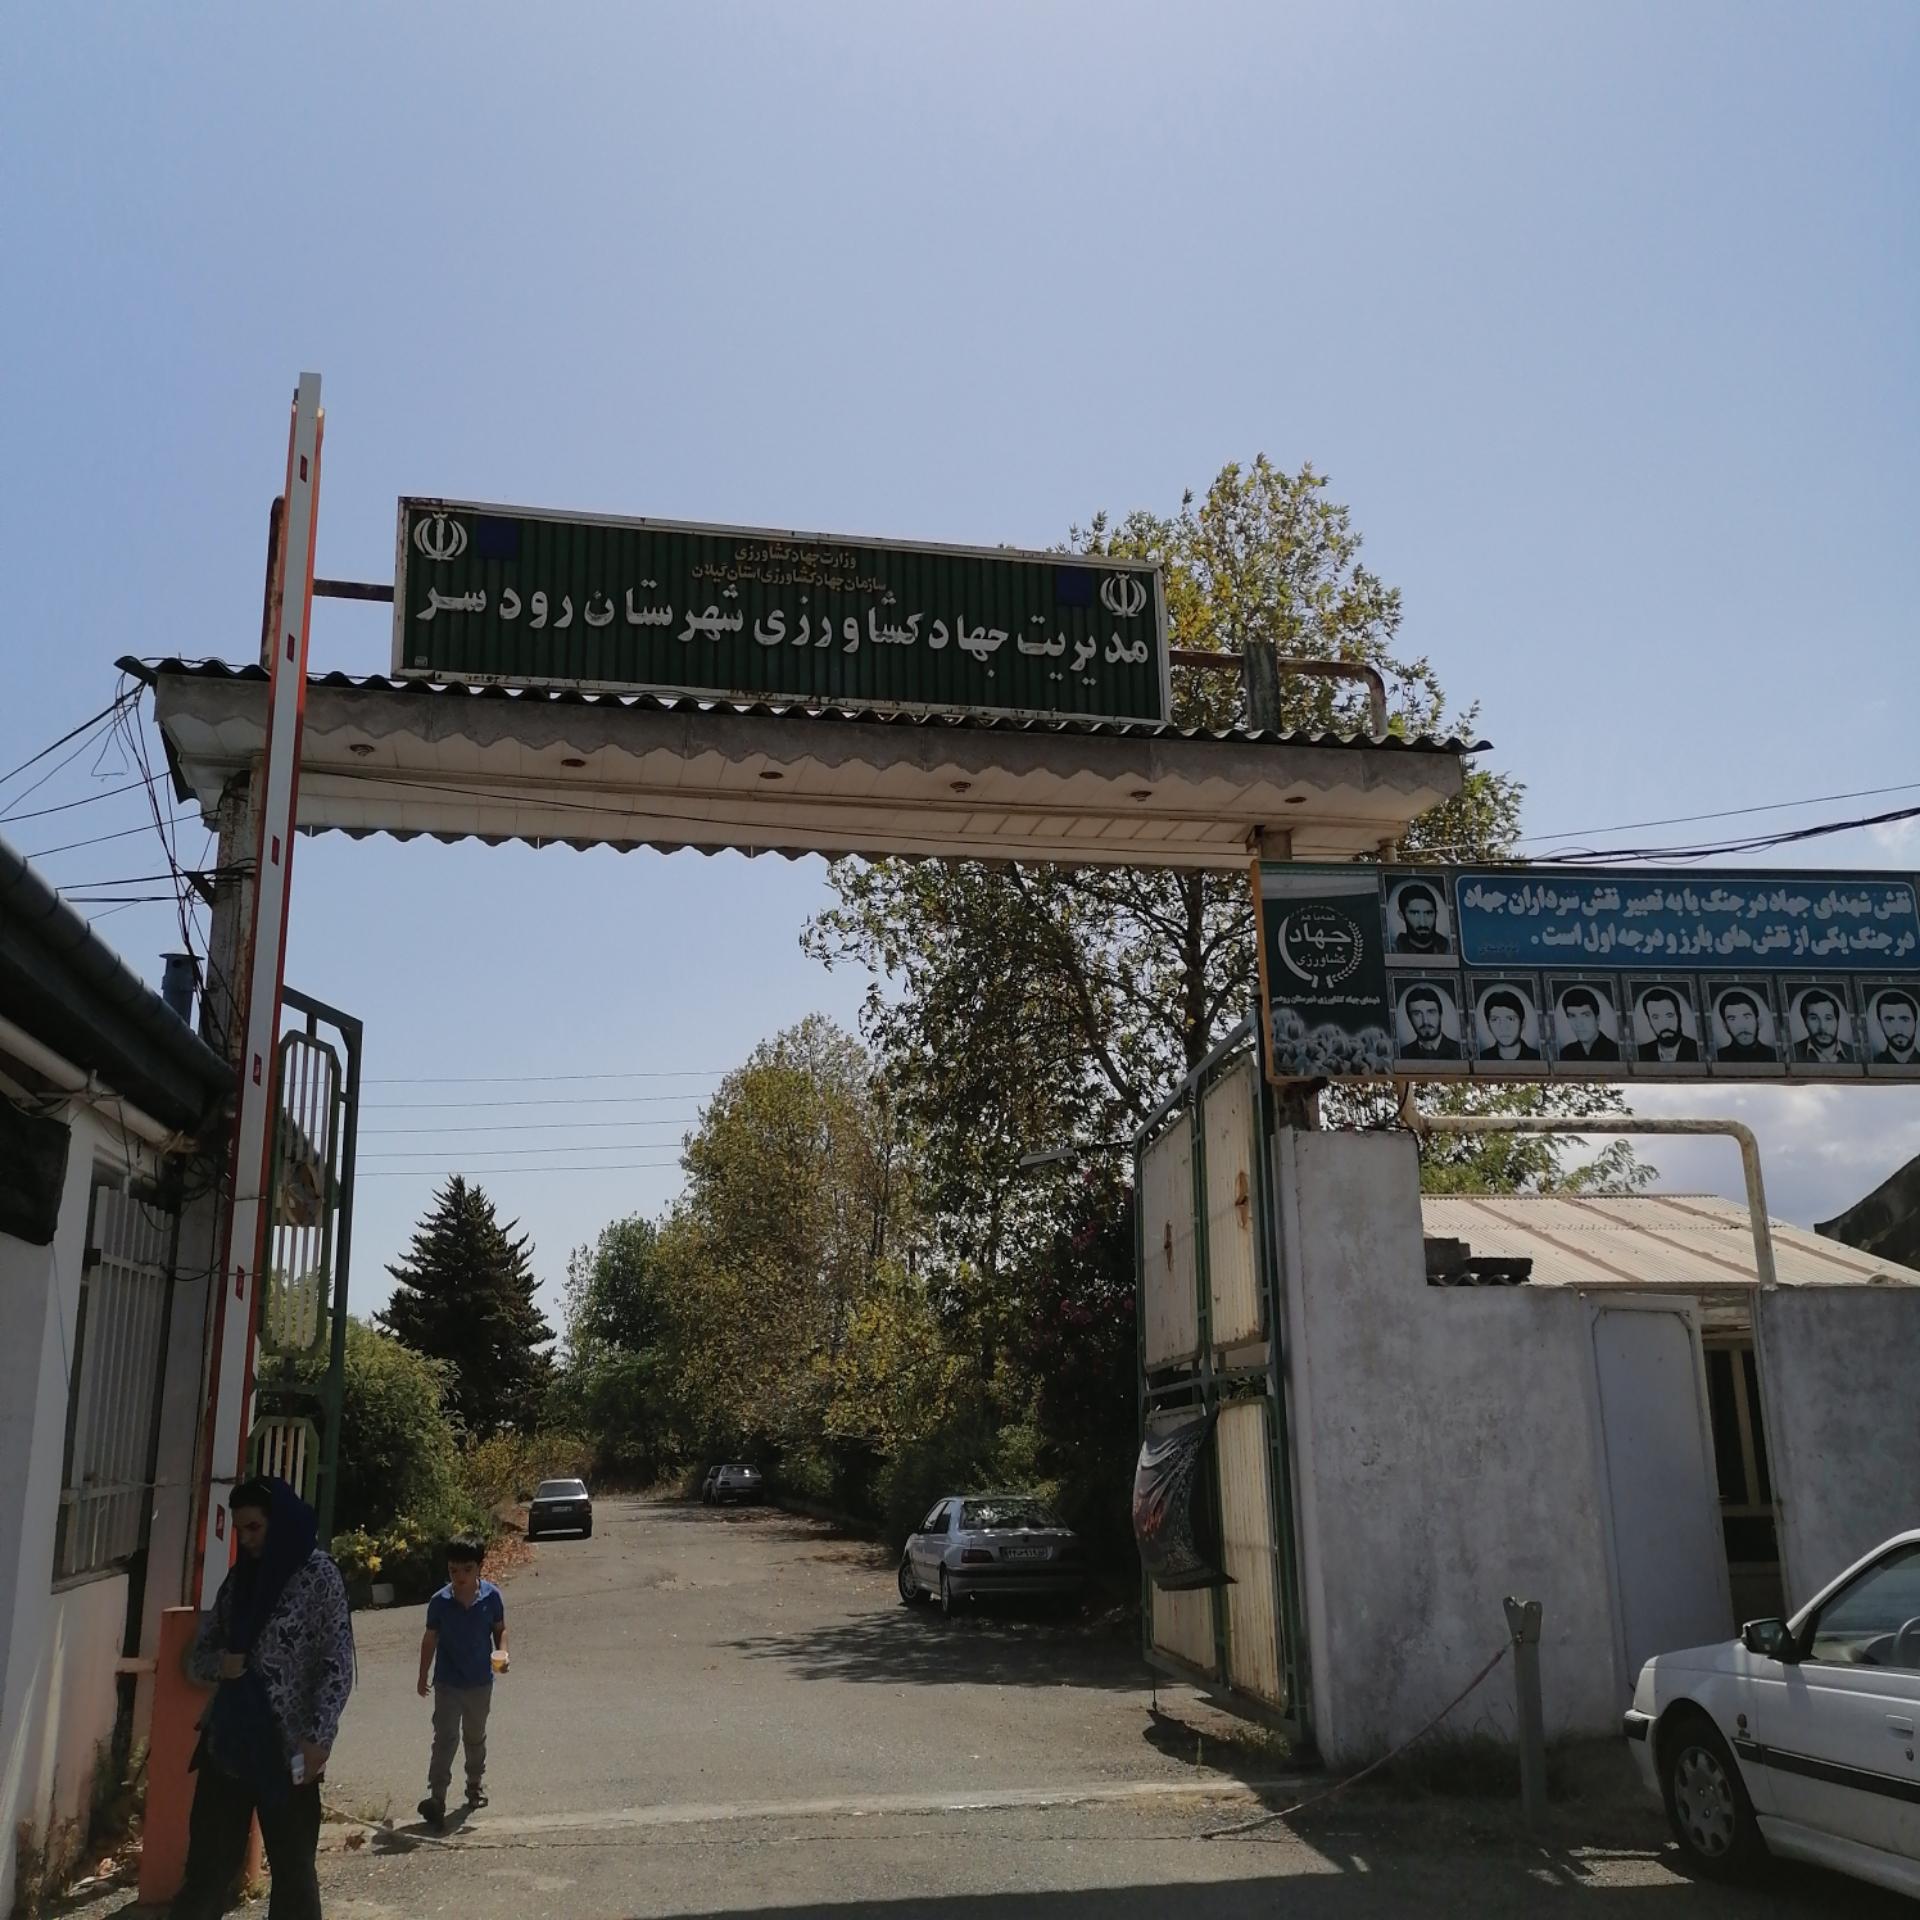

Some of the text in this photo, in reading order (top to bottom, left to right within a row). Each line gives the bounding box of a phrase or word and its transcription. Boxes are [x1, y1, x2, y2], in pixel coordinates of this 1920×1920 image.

[734, 542, 857, 569] وزارت جهاد کشاورزی
[691, 562, 887, 593] سازمان جهاد کشاورزی استان گیلان
[583, 579, 744, 642] شهرستان
[753, 590, 925, 653] کشاورزی
[928, 614, 1009, 678] جهاد
[1017, 614, 1149, 686] مدیریت
[1464, 884, 1507, 914] جهاد
[1508, 884, 1580, 916] سرداران
[1581, 887, 1621, 916] نقش
[1665, 891, 1683, 917] به
[1682, 887, 1701, 917] یا
[1701, 888, 1745, 918] جنگ
[1746, 892, 1768, 919] در
[1768, 888, 1811, 919] جهاد
[1813, 889, 1873, 920] شهدای
[1873, 890, 1913, 920] نقش
[1289, 921, 1352, 952] جهاد
[1583, 921, 1616, 954] اول
[1617, 927, 1664, 954] درجه
[1678, 923, 1713, 955] بارز
[1714, 923, 1752, 955] های
[1752, 924, 1792, 955] نقش
[1792, 924, 1810, 956] از
[1811, 925, 1850, 956] یکی
[1849, 926, 1893, 955] جنگ
[1894, 930, 1916, 957] در
[1296, 952, 1346, 968] کشاورزی
